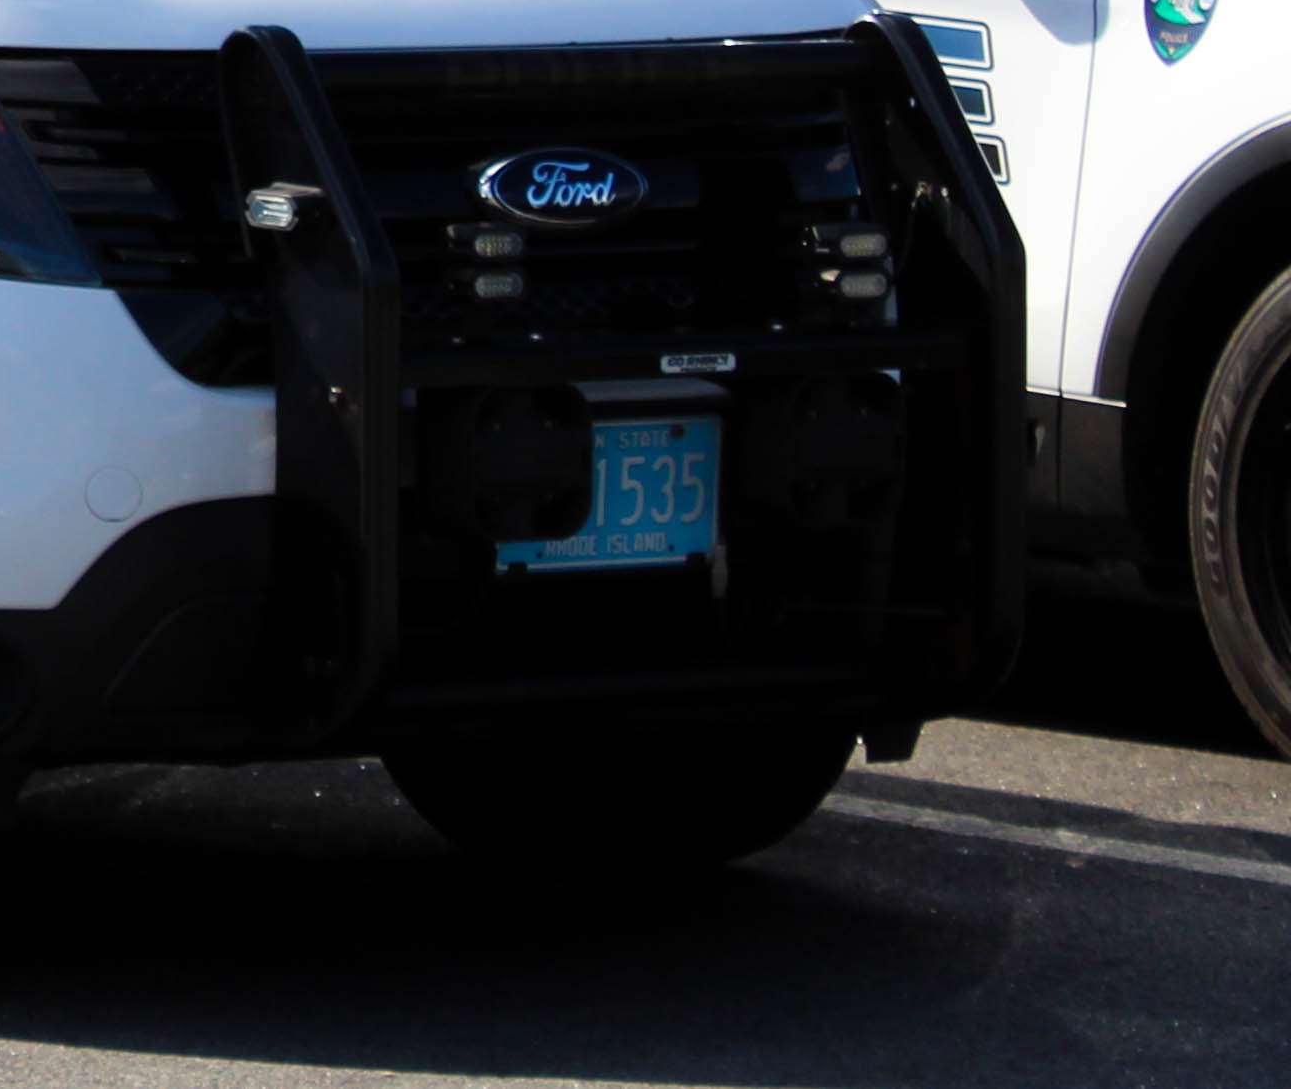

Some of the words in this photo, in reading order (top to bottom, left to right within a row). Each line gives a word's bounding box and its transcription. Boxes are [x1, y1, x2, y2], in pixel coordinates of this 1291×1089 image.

[527, 162, 617, 209] Ford
[619, 430, 671, 450] STATE
[596, 452, 708, 527] 1535
[545, 535, 599, 559] RHODE
[606, 531, 668, 555] ISLAND
